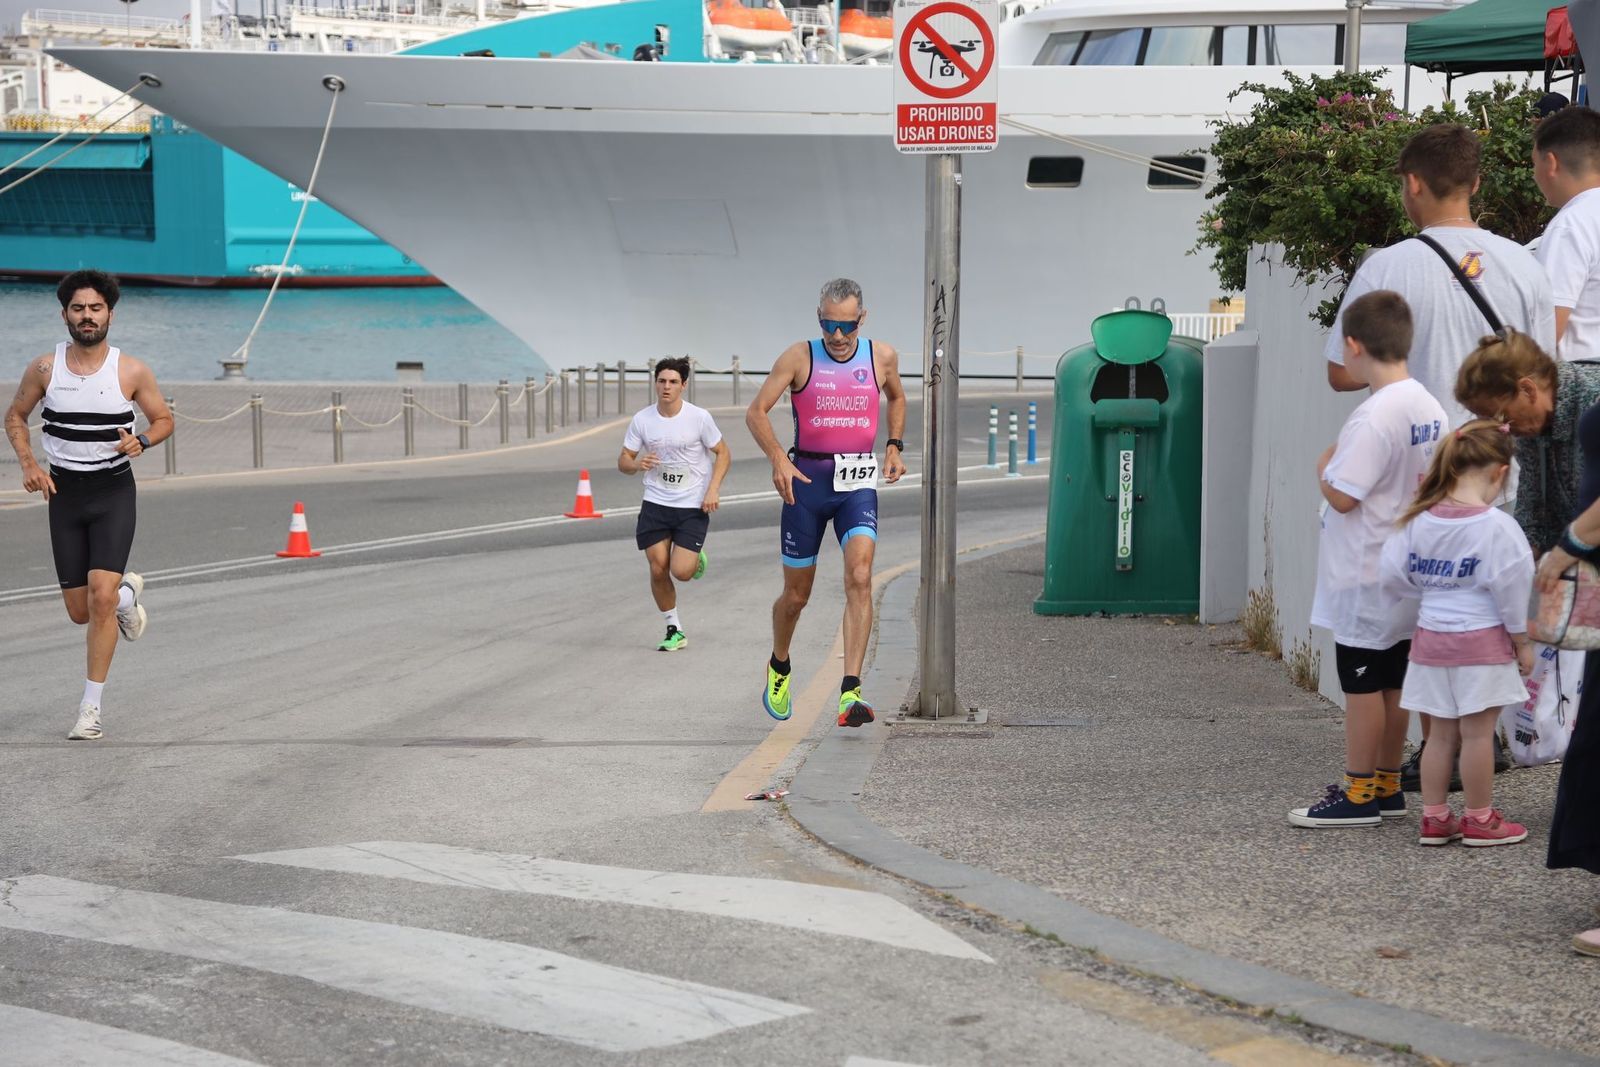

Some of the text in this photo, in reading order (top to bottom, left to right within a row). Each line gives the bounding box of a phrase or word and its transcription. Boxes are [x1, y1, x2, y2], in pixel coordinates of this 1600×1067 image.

[910, 106, 984, 122] PROHIBIDO
[900, 125, 994, 142] USAR DRONES
[816, 395, 869, 411] BARRANQUERO
[662, 472, 684, 483] 887
[839, 466, 876, 480] 1157
